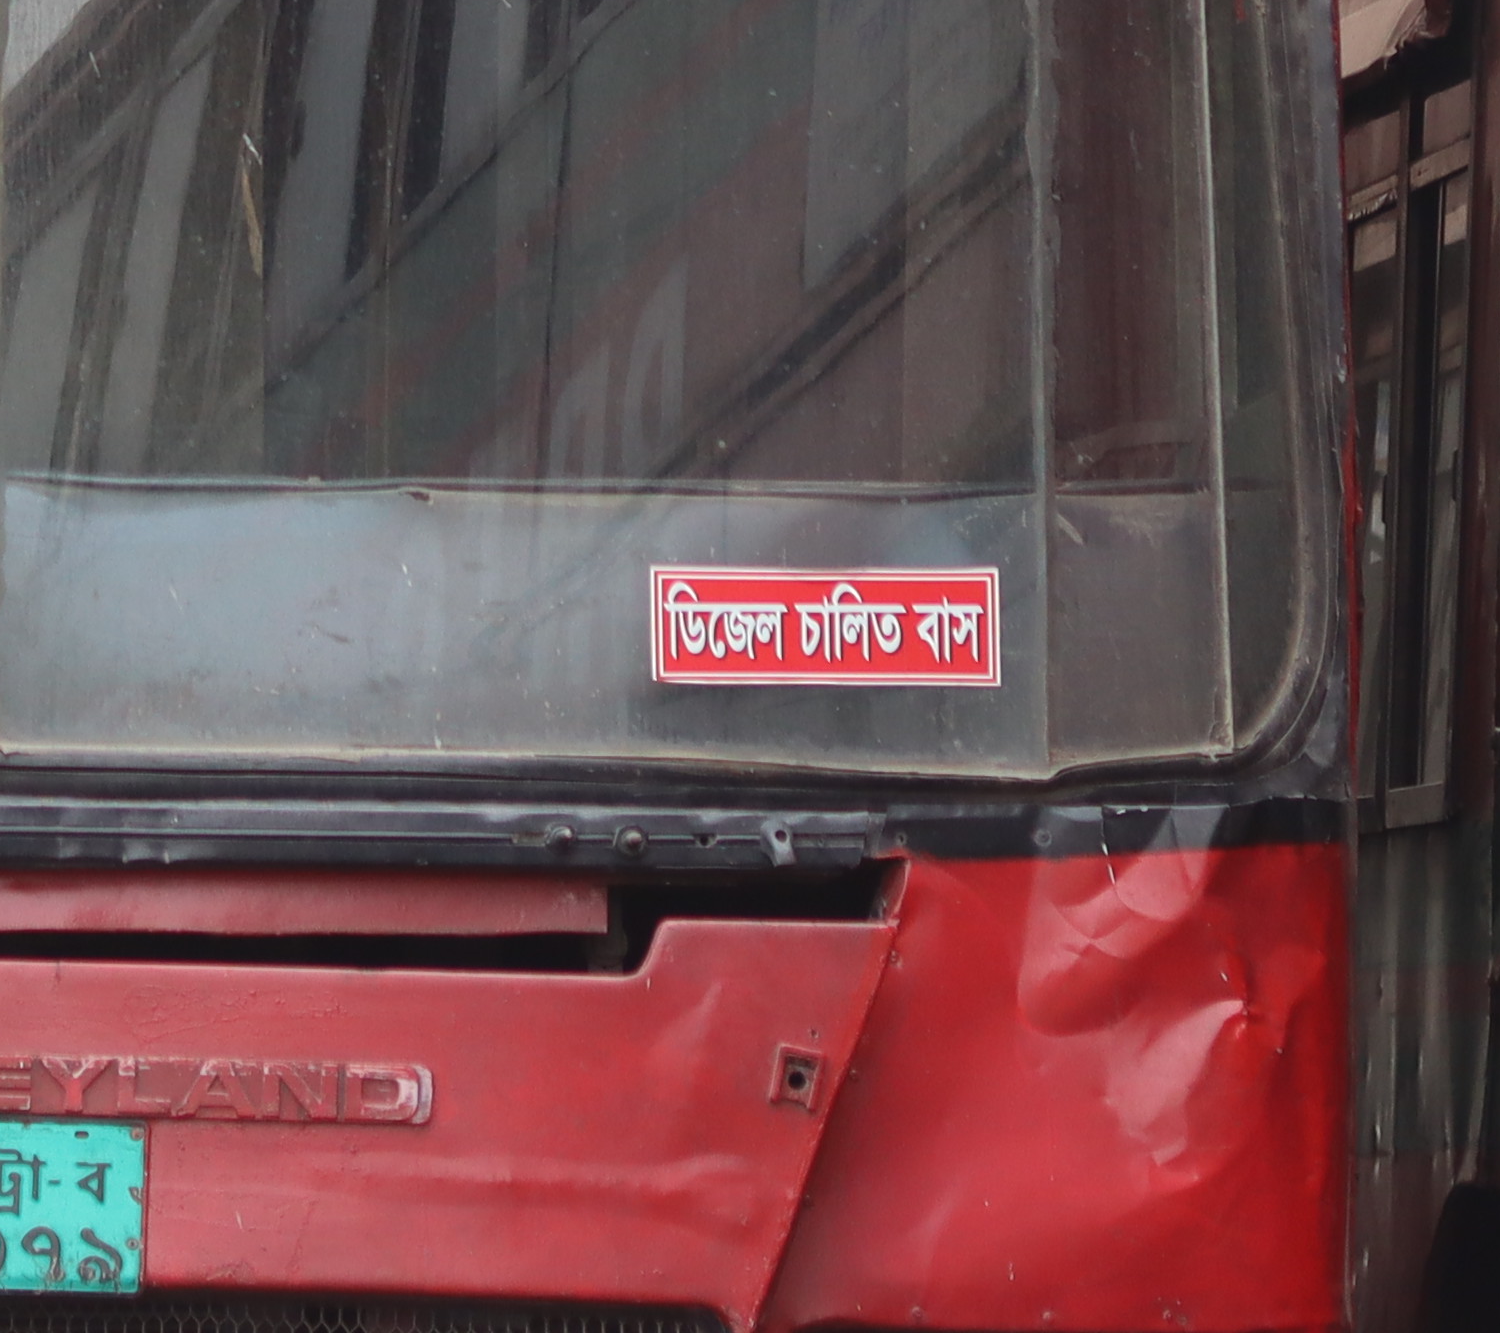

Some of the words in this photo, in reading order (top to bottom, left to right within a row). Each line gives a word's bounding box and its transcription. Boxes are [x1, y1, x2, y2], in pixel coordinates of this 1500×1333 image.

[664, 581, 788, 661] ডিজেল
[794, 582, 906, 663] চালিত
[912, 596, 984, 663] বাস
